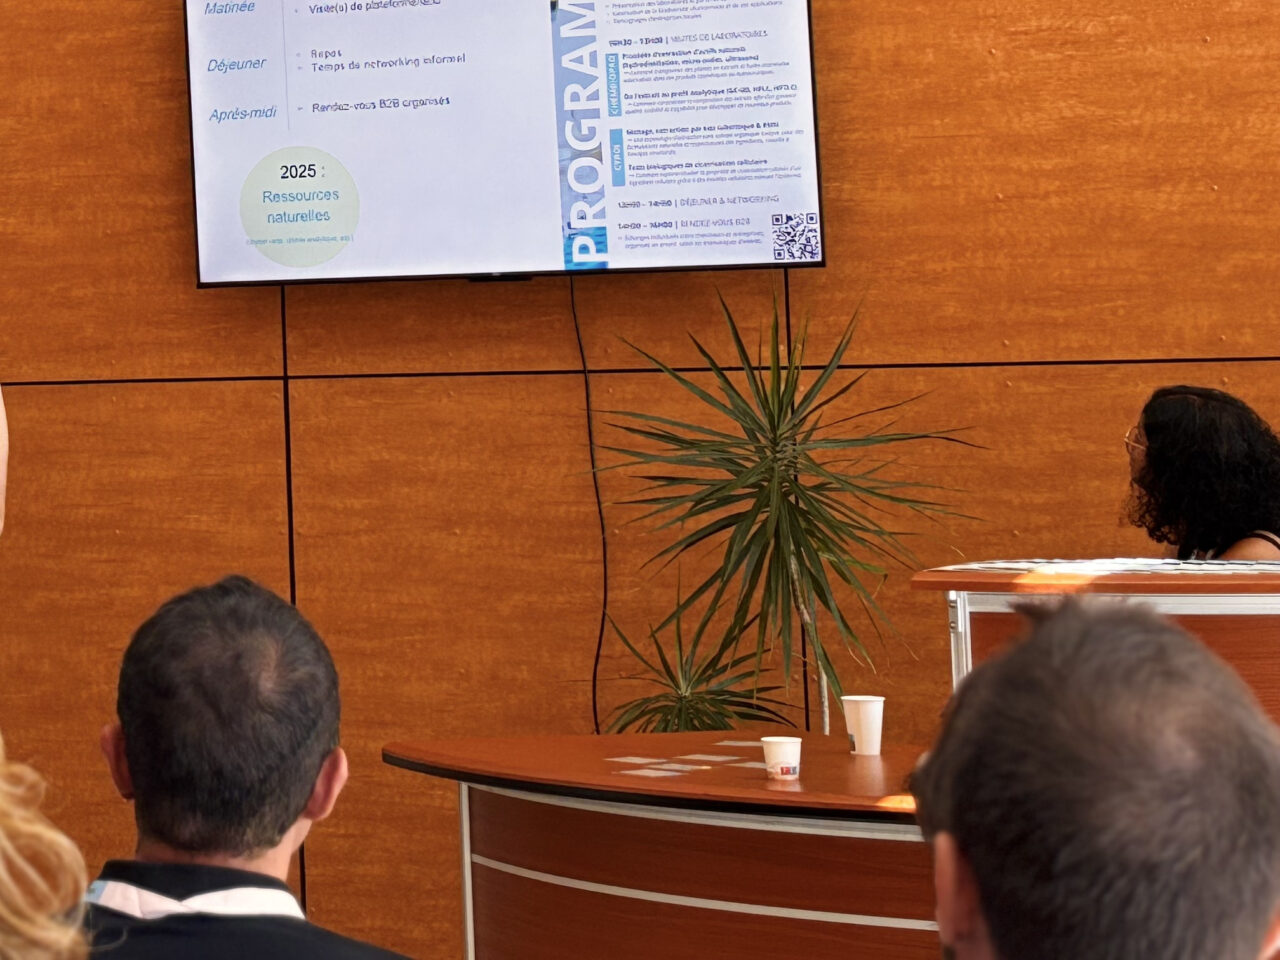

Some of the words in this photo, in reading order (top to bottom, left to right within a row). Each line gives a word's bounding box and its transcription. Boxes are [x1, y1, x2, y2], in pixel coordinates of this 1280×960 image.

[204, 0, 256, 15] Matinée
[207, 57, 268, 74] Déjeuner
[311, 61, 346, 74] Temps
[209, 105, 278, 123] Après-midi
[280, 163, 317, 180] 2025
[262, 189, 340, 205] Ressources
[267, 210, 331, 224] naturelles
